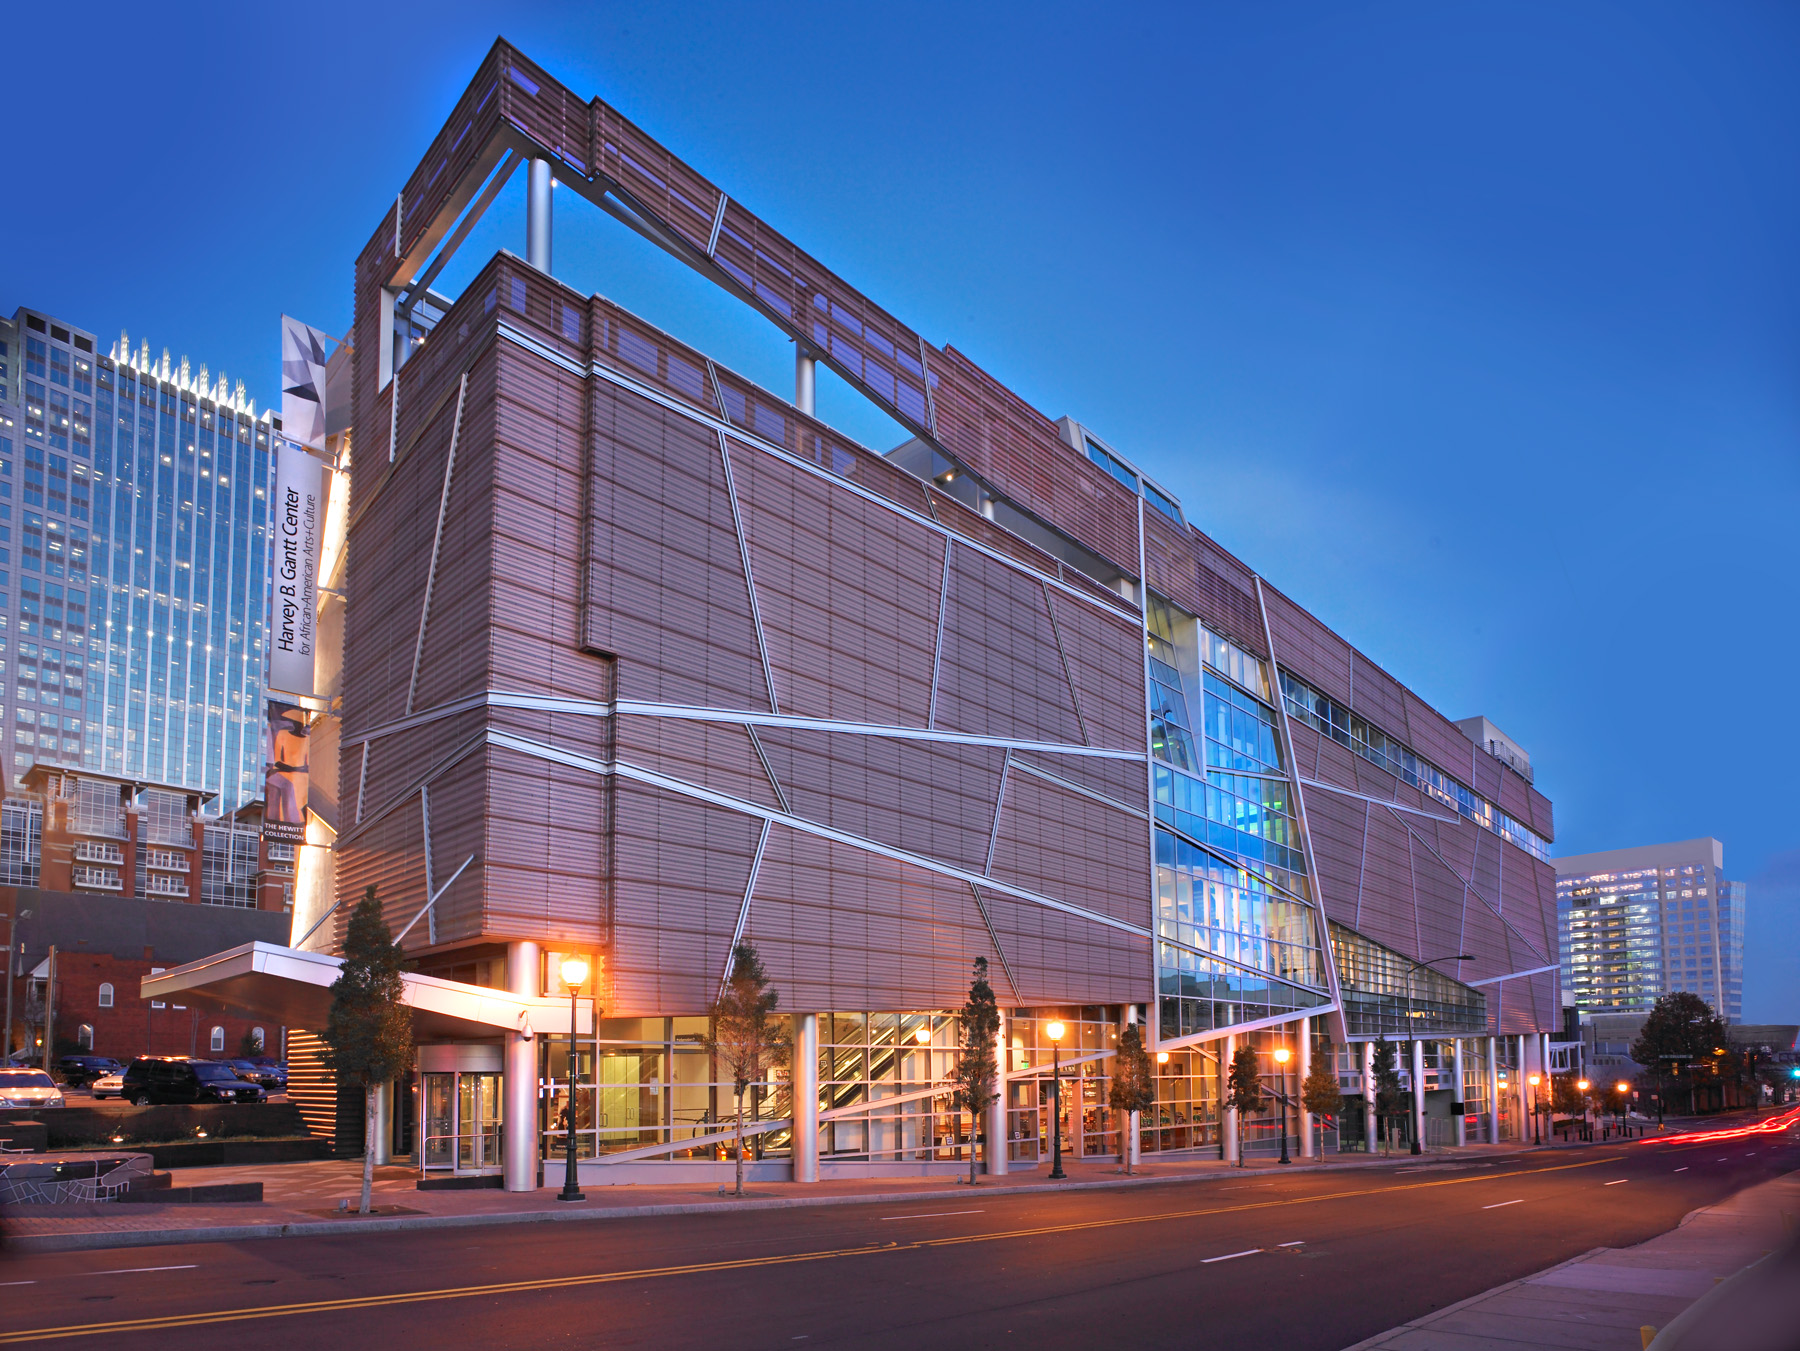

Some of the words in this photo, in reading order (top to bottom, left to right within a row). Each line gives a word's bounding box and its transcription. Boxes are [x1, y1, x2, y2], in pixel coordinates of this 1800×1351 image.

[282, 486, 299, 536] Center
[303, 494, 316, 557] Arts+Culture
[280, 538, 297, 580] Gantt
[280, 585, 296, 597] B.
[299, 559, 313, 640] African-American
[278, 599, 299, 652] Harvey
[299, 642, 311, 656] for
[264, 830, 304, 840] COLLECTION
